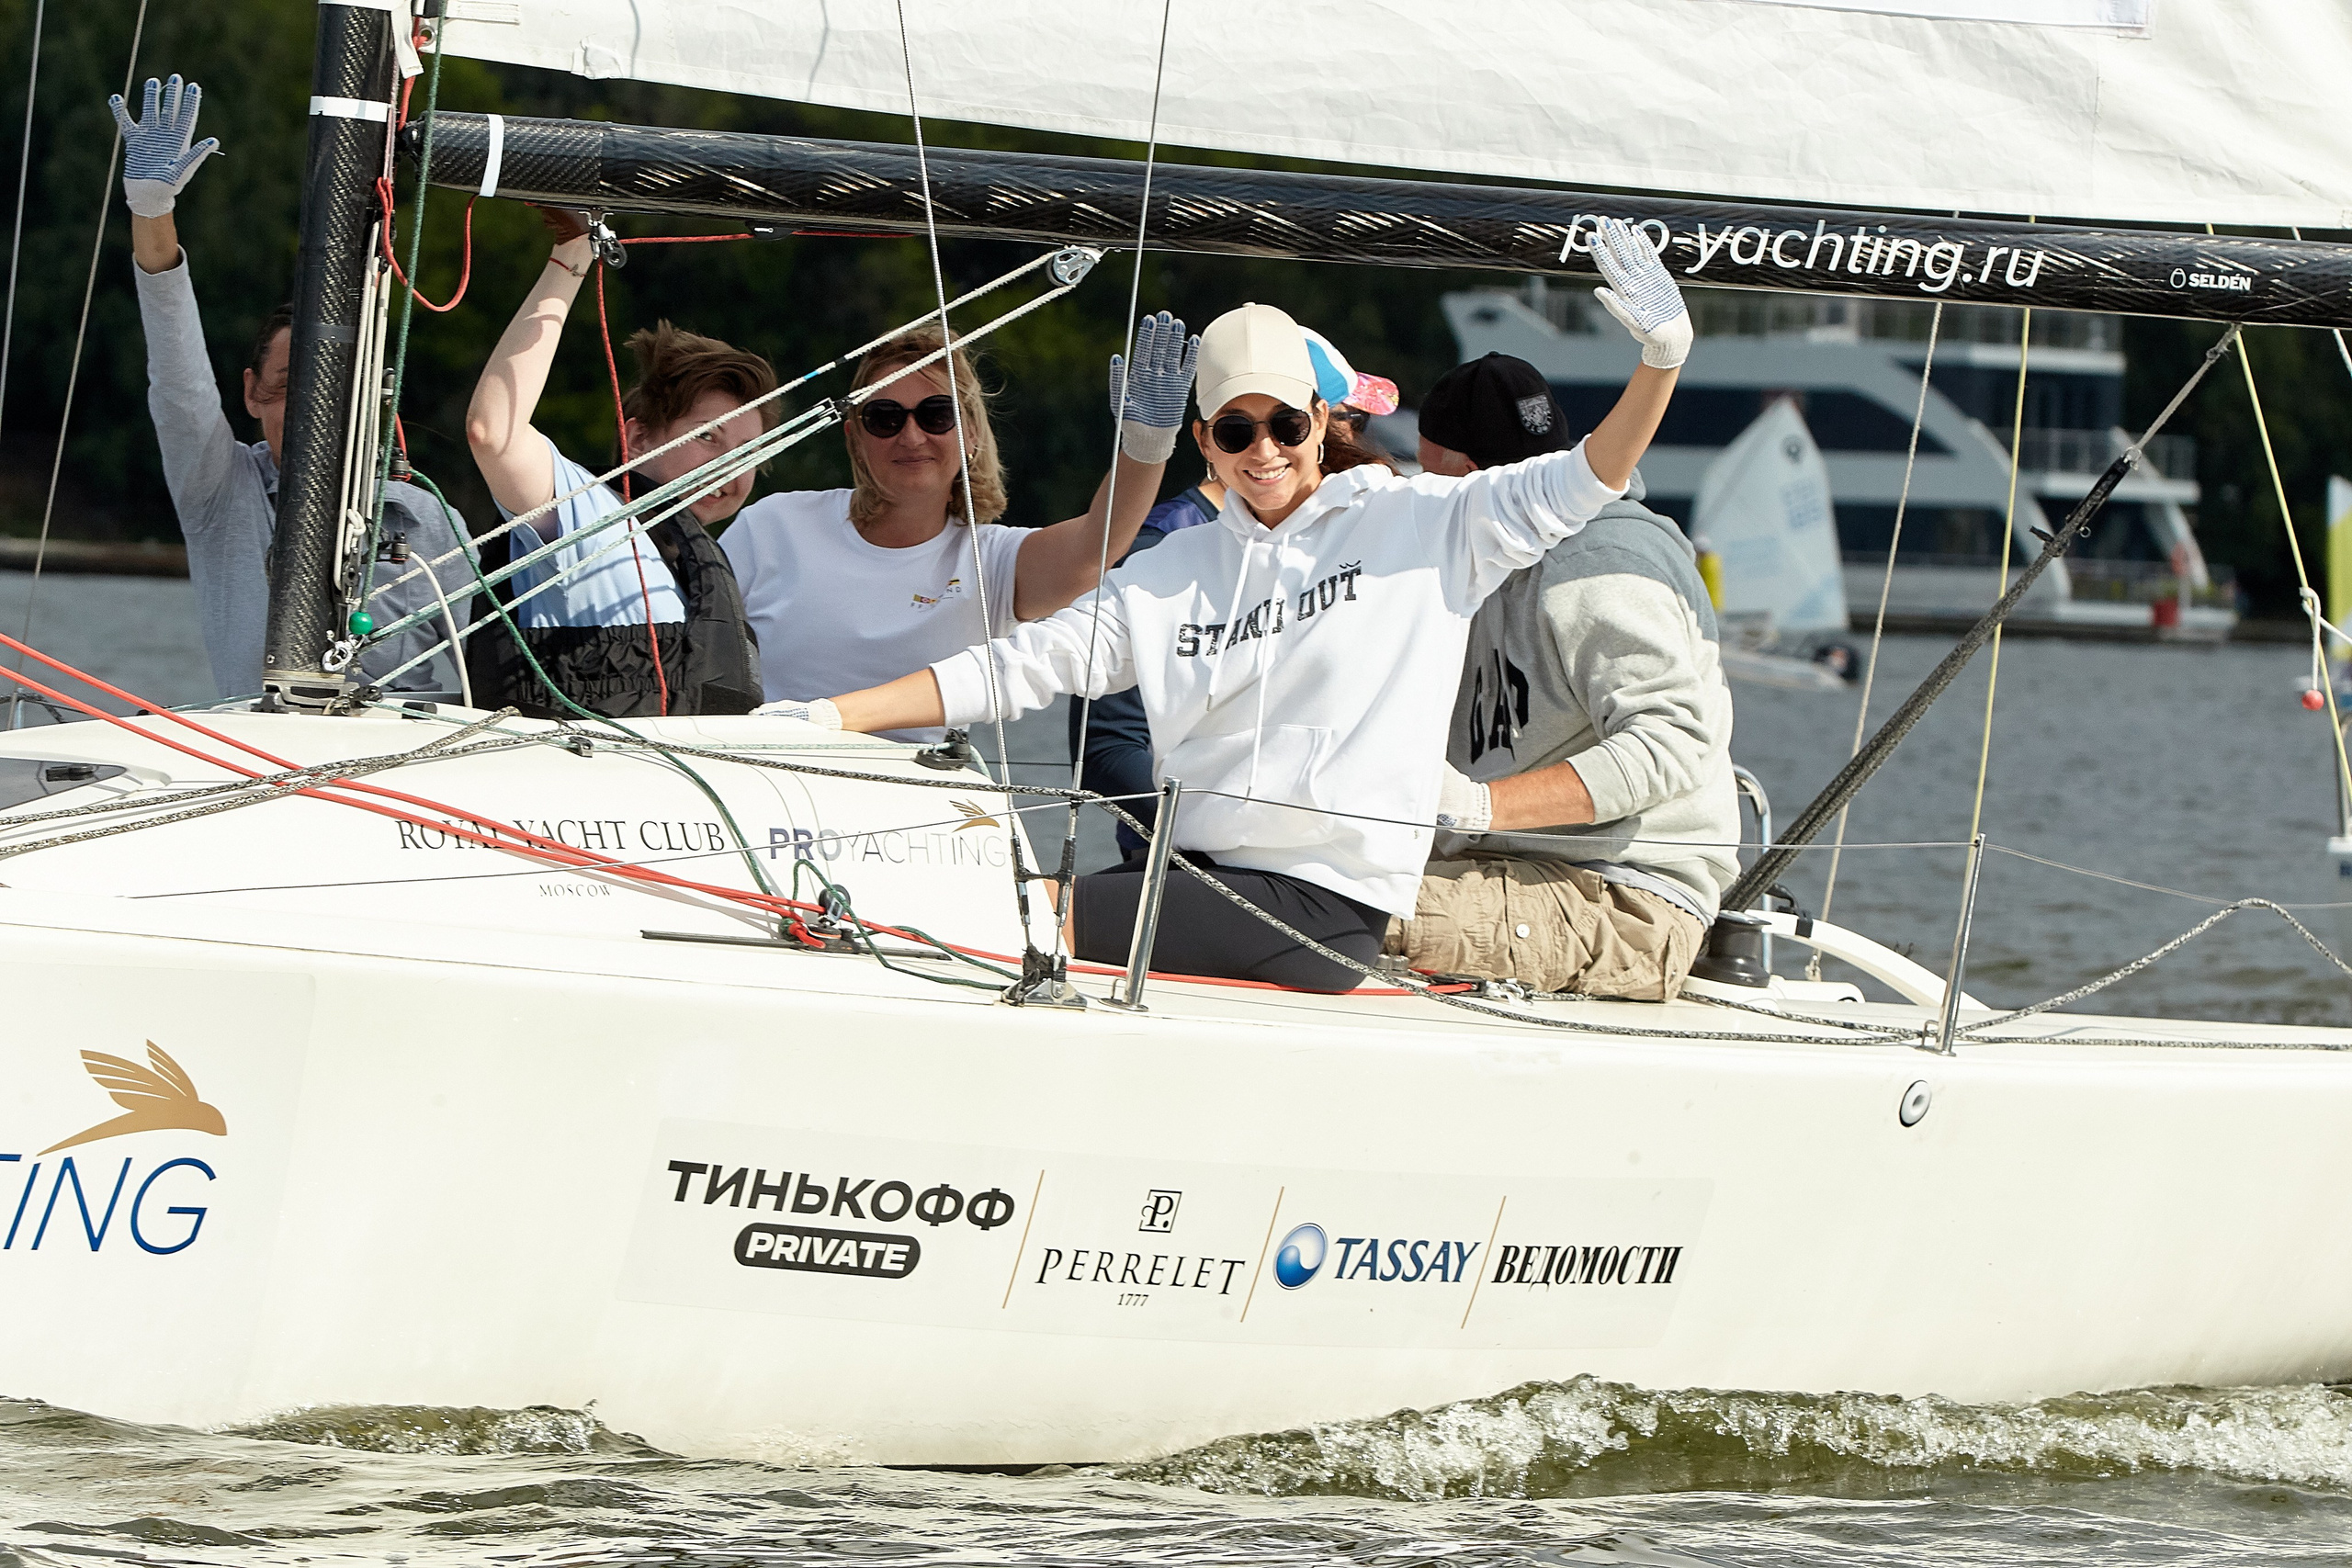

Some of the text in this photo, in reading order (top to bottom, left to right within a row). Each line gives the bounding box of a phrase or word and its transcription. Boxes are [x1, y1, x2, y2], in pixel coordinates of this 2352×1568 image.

[2188, 273, 2252, 291] SELDÉN
[1297, 564, 1363, 621] OUT
[513, 819, 627, 851] YACHT
[639, 820, 726, 852] CLUB
[769, 828, 1007, 868] PROYACHTING
[539, 884, 612, 897] MOSCOW
[667, 1159, 1015, 1231] ТИНЬКОФФ
[744, 1231, 910, 1272] PRIVATE
[1035, 1247, 1246, 1295] PERRELET
[1334, 1236, 1481, 1283] TASSAY
[1490, 1245, 1683, 1292] ВЕДОМОСТИ
[1117, 1292, 1149, 1307] 1777
